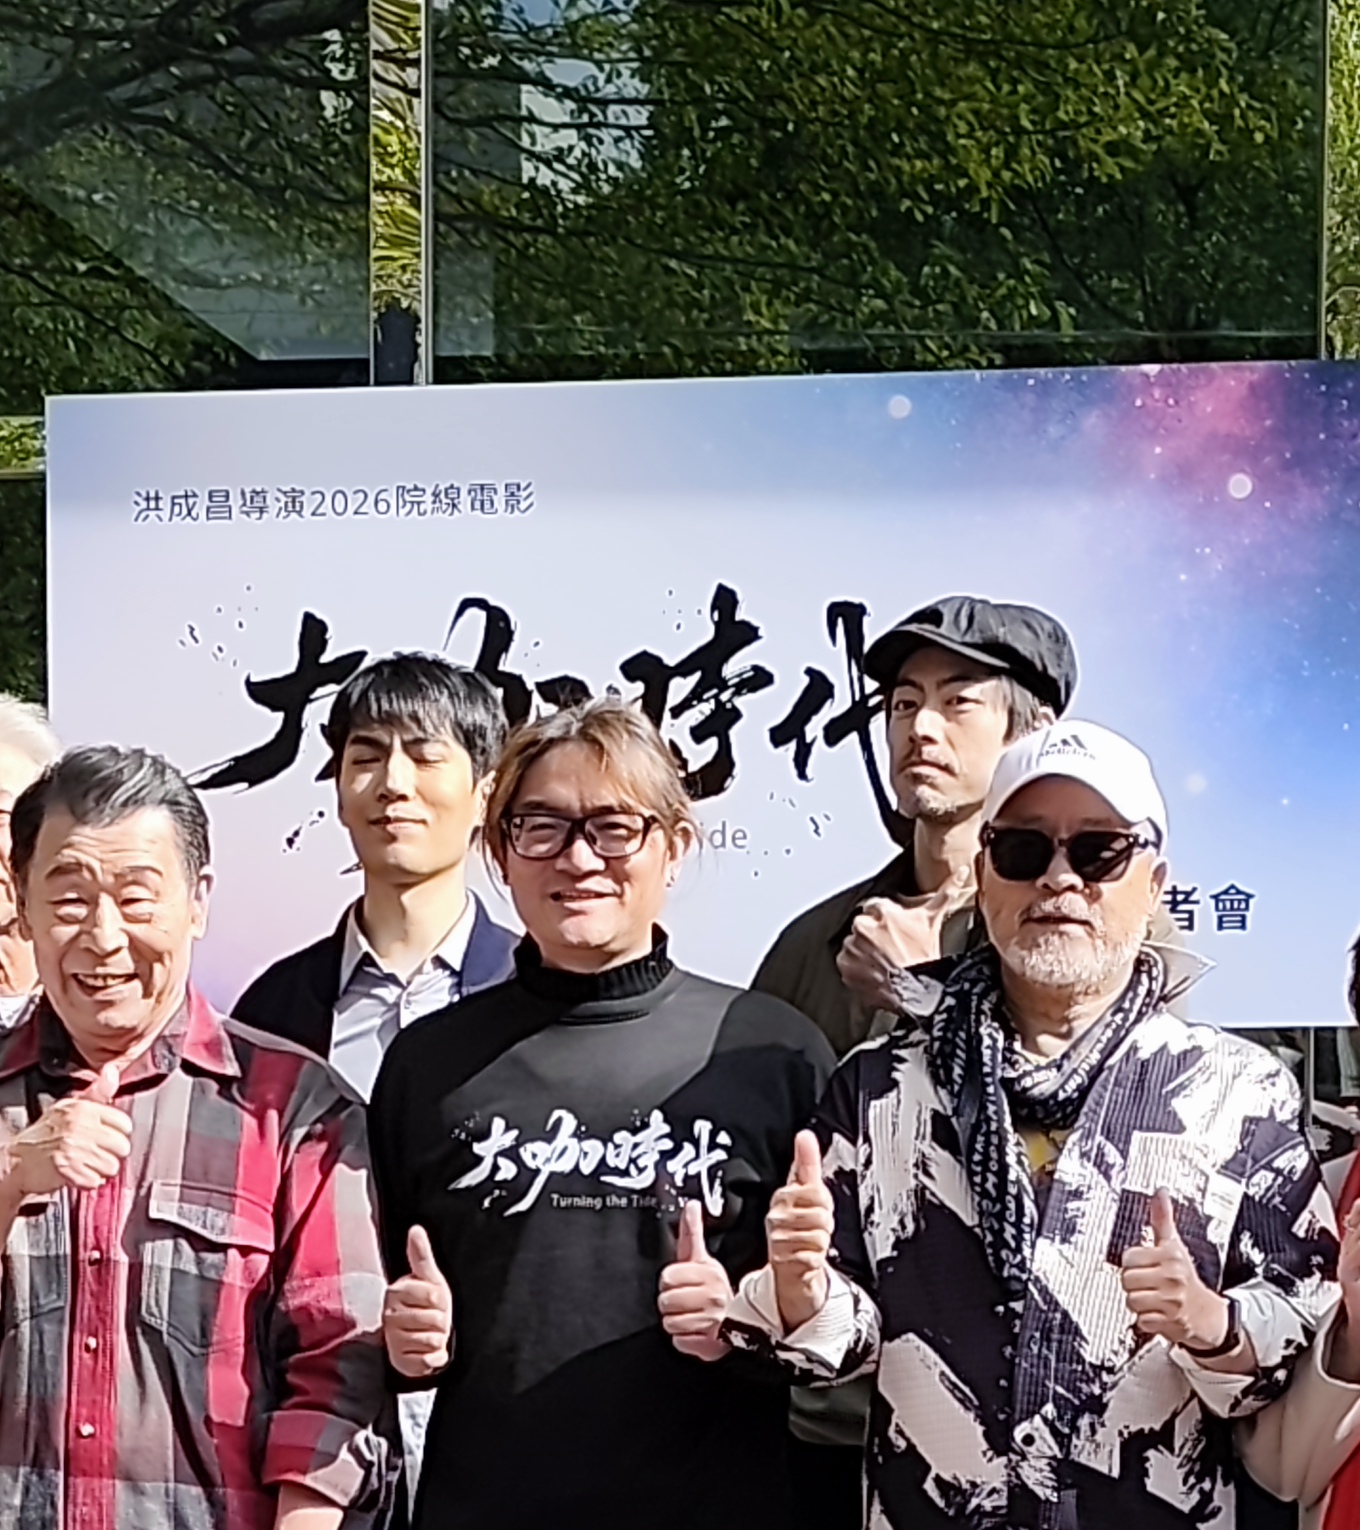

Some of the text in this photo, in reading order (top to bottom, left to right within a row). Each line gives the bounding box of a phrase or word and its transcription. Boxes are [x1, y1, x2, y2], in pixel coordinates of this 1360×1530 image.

[132, 481, 536, 524] 洪成昌導演2026院線電影
[448, 1109, 732, 1216] 大咖時代
[551, 1194, 601, 1211] Turning
[606, 1194, 627, 1208] the
